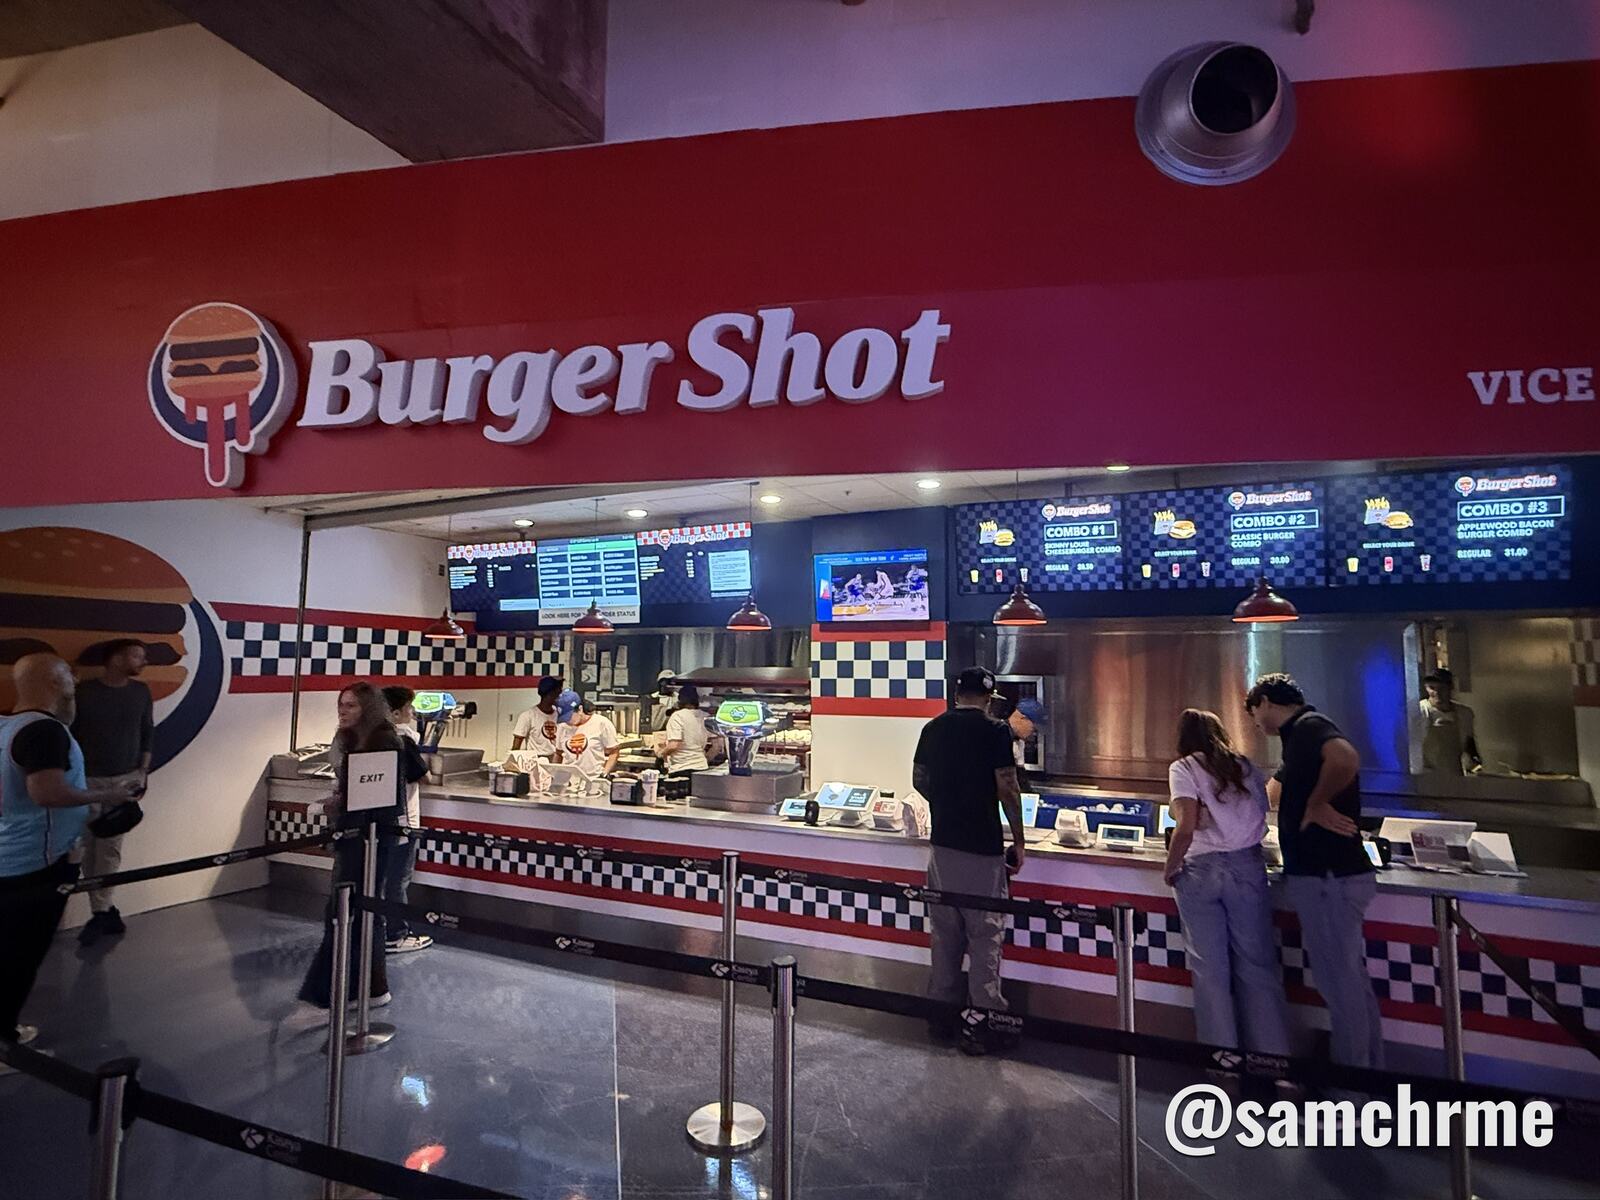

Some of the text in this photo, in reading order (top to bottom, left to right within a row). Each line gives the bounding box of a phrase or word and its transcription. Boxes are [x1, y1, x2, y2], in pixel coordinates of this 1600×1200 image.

[297, 306, 951, 445] Burger Shot
[1467, 367, 1595, 405] VICE
[1476, 479, 1523, 492] Burger
[1460, 501, 1548, 517] COMBO #3
[1233, 514, 1306, 529] COMBO #2
[1457, 519, 1555, 531] APPLEWOOD BACON
[1045, 524, 1106, 538] COMBO #1
[1231, 531, 1296, 541] CLASSIC BURGER
[1457, 528, 1534, 539] BURGER COMBO
[1095, 545, 1122, 554] COMBO
[1231, 540, 1262, 549] COMBO
[1457, 549, 1492, 559] REGULAR
[359, 773, 385, 784] EXIT
[988, 1011, 1024, 1026] Kaseya
